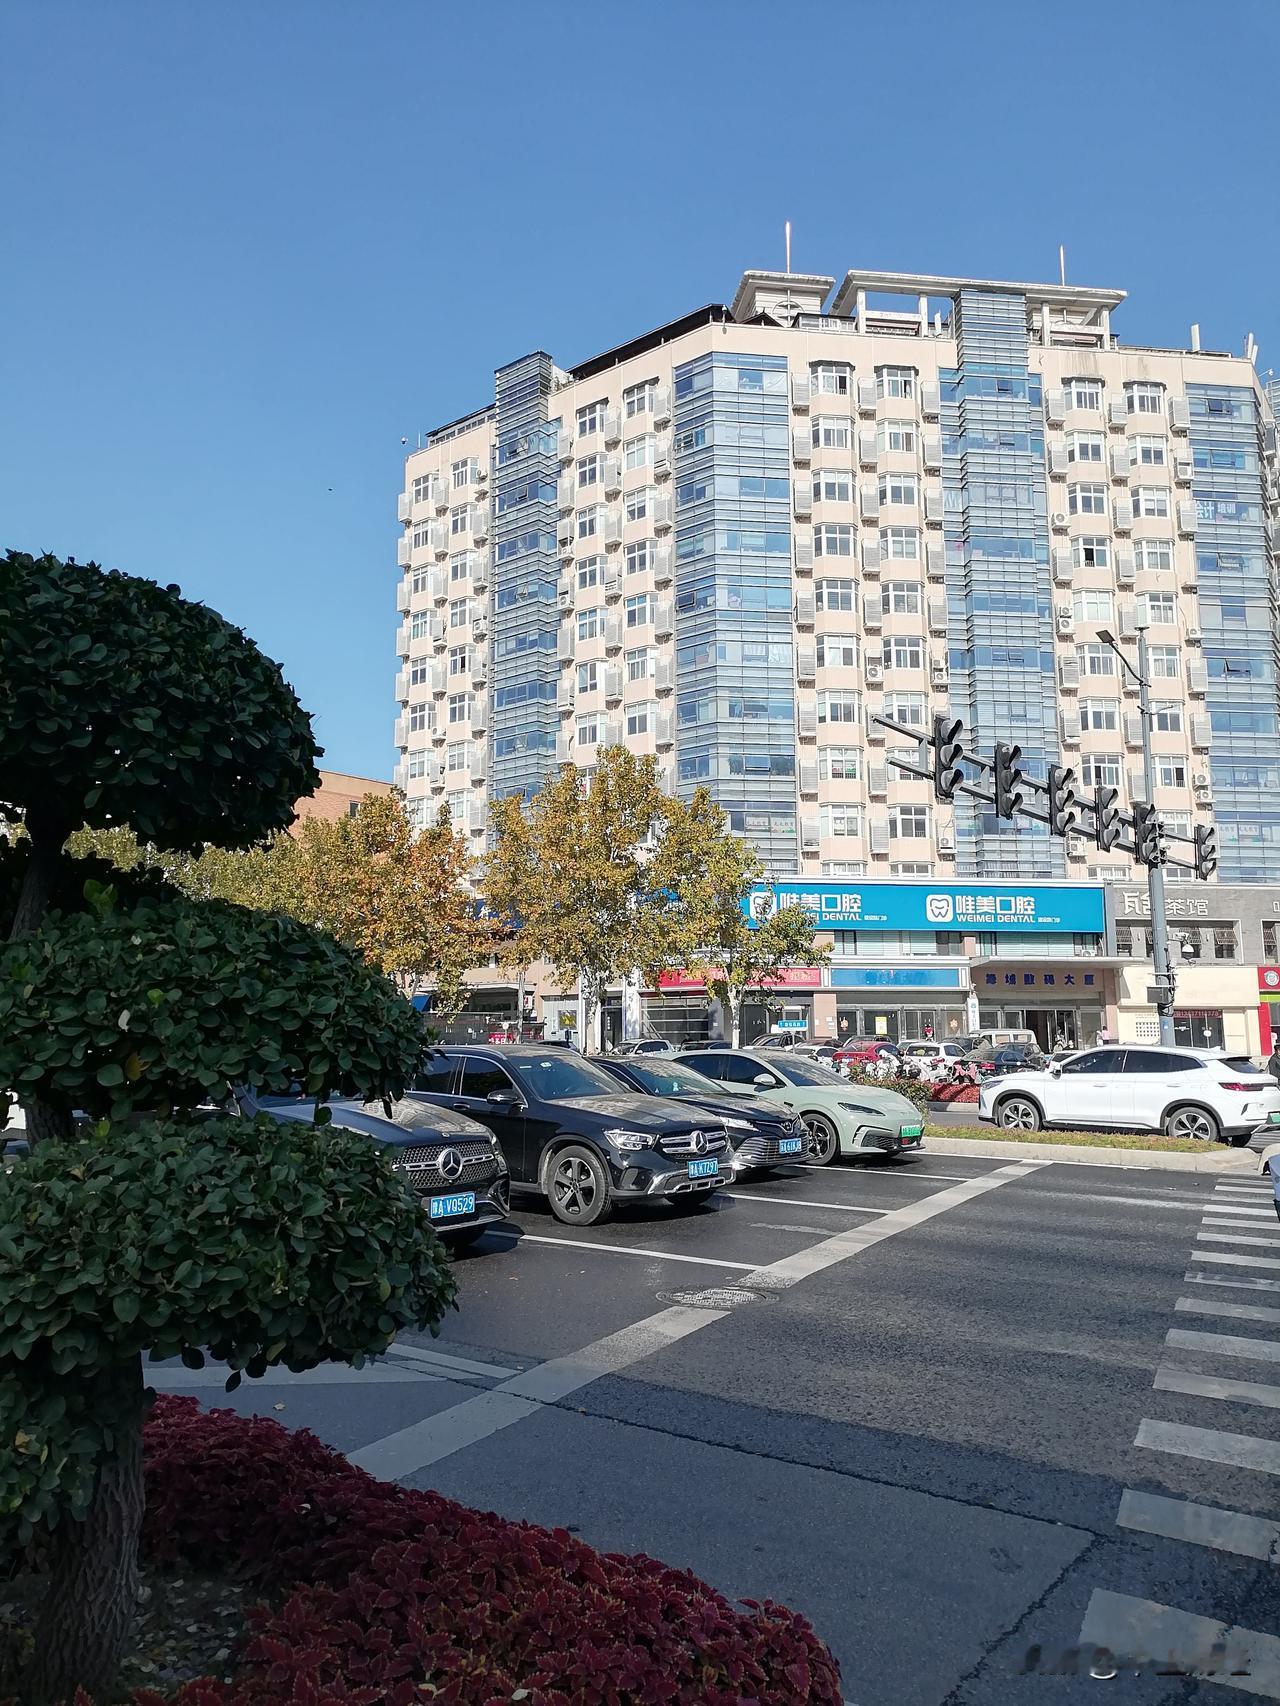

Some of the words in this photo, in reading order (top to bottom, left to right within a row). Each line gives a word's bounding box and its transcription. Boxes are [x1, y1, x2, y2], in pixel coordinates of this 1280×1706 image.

[779, 892, 862, 913] 唯美口腔
[955, 895, 1036, 915] 唯美口腔
[822, 912, 862, 921] DENTAL
[956, 914, 994, 923] WEIMEI
[997, 914, 1036, 923] DENTAL
